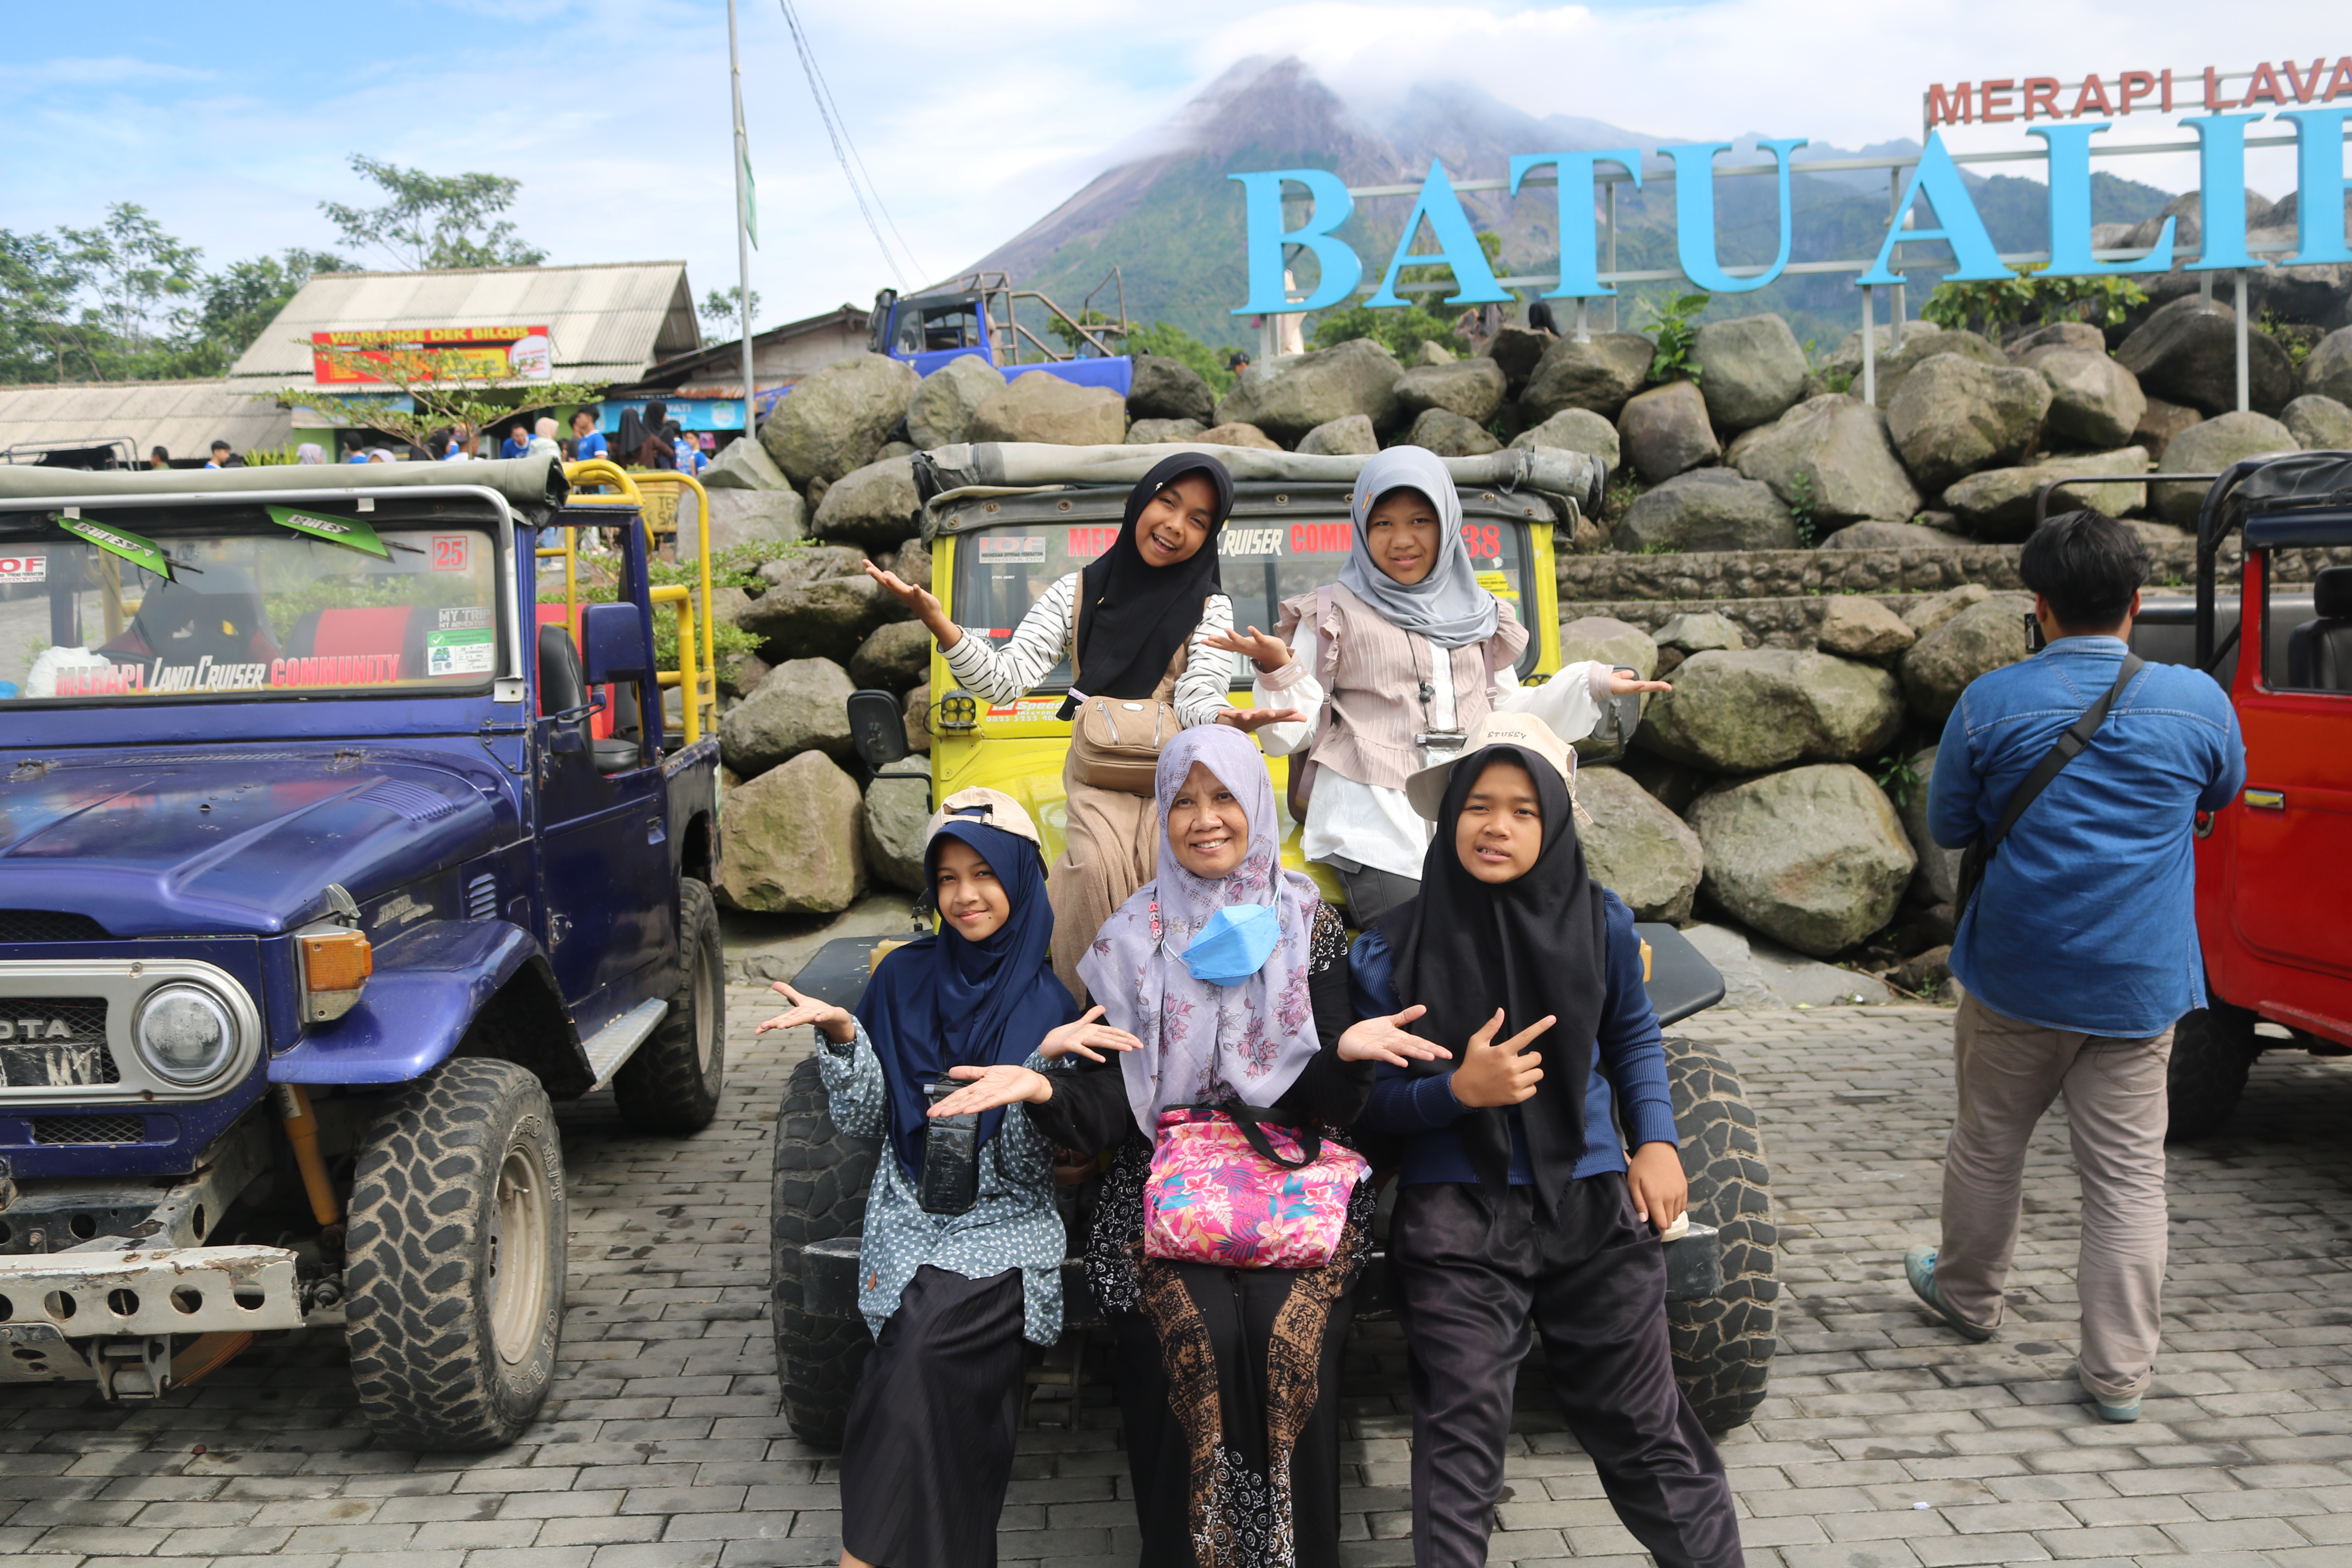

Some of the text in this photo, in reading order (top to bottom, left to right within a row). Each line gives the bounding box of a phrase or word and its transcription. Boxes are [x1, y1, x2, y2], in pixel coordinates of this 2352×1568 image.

[1929, 56, 2352, 125] MERAPI LAVA
[1227, 138, 1808, 314] BATU
[430, 328, 467, 341] DEK
[470, 326, 530, 340] BILQIS
[436, 541, 463, 565] 25
[981, 537, 1044, 552] IOF
[1461, 524, 1501, 558] 38
[439, 609, 491, 622] MY TRIP
[56, 663, 144, 696] MERAPI
[271, 654, 400, 688] COMMUNITY
[1487, 731, 1527, 739] STUSSY
